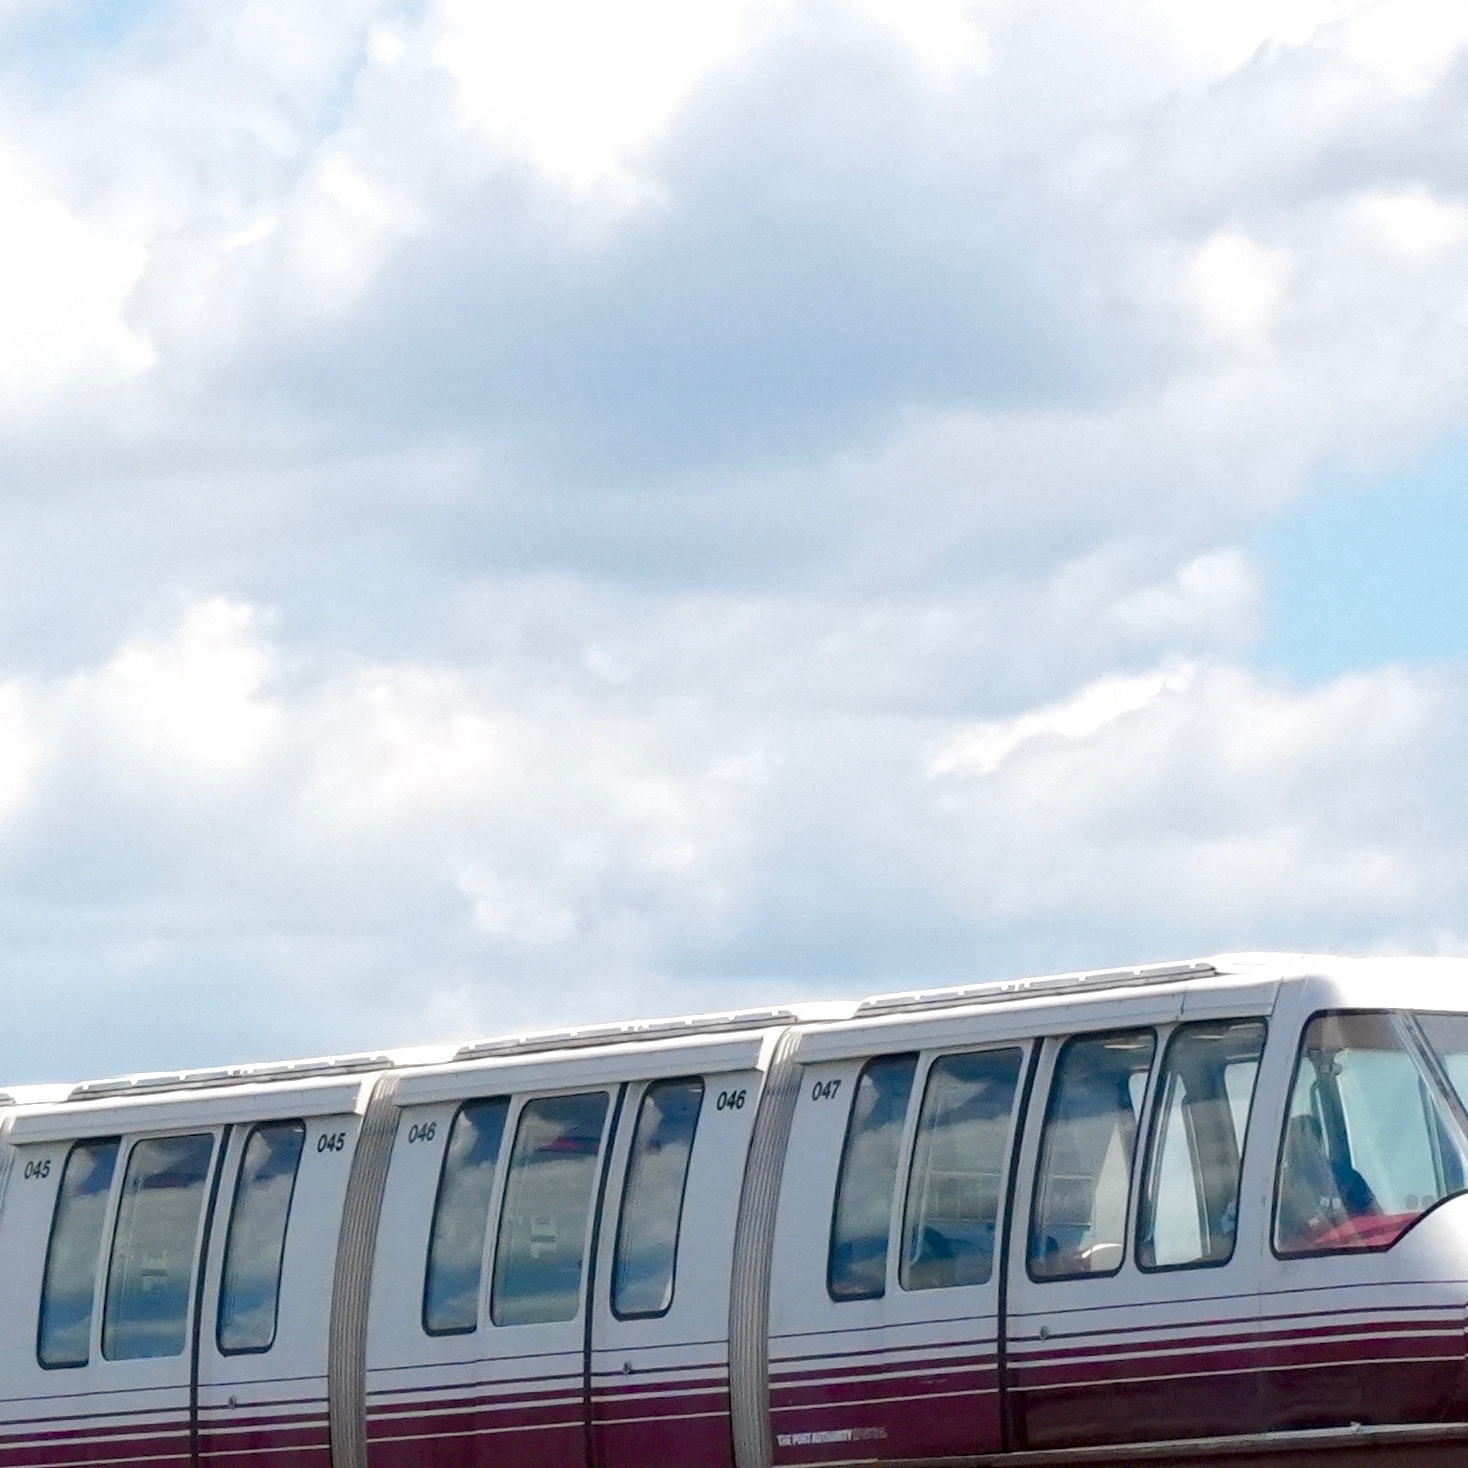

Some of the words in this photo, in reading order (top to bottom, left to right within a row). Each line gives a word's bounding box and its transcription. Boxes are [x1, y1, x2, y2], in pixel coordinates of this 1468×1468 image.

[716, 1090, 746, 1110] 046
[812, 1079, 841, 1101] 047
[317, 1132, 346, 1153] 045
[408, 1122, 437, 1144] 046
[24, 1159, 51, 1179] 045
